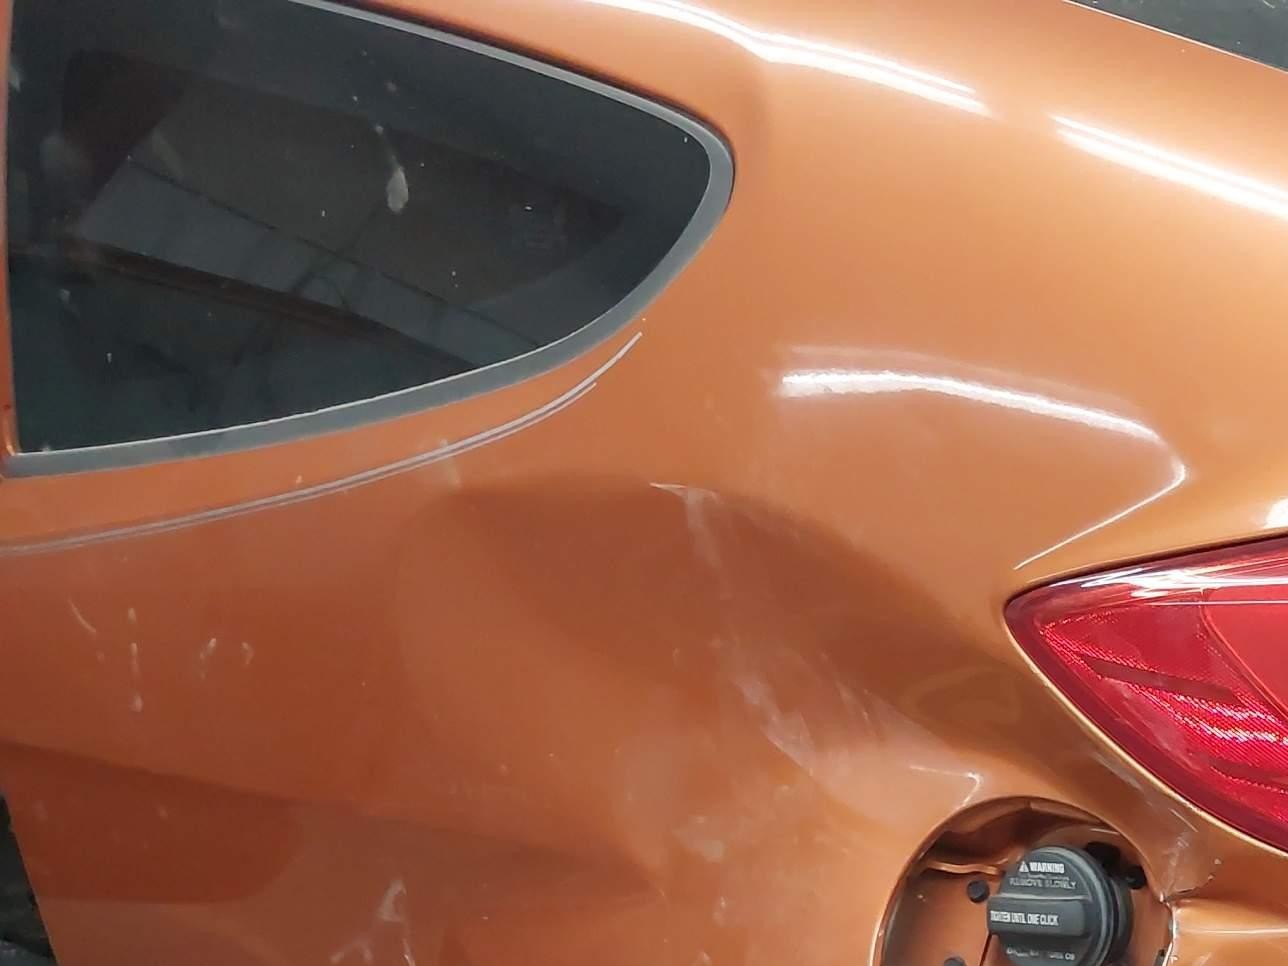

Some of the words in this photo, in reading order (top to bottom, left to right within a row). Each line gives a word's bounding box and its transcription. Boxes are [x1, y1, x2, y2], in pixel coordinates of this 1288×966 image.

[1029, 862, 1065, 873] WARNING
[1011, 912, 1026, 924] UNTIL
[1027, 913, 1040, 925] ONE
[1040, 914, 1059, 926] CLICK
